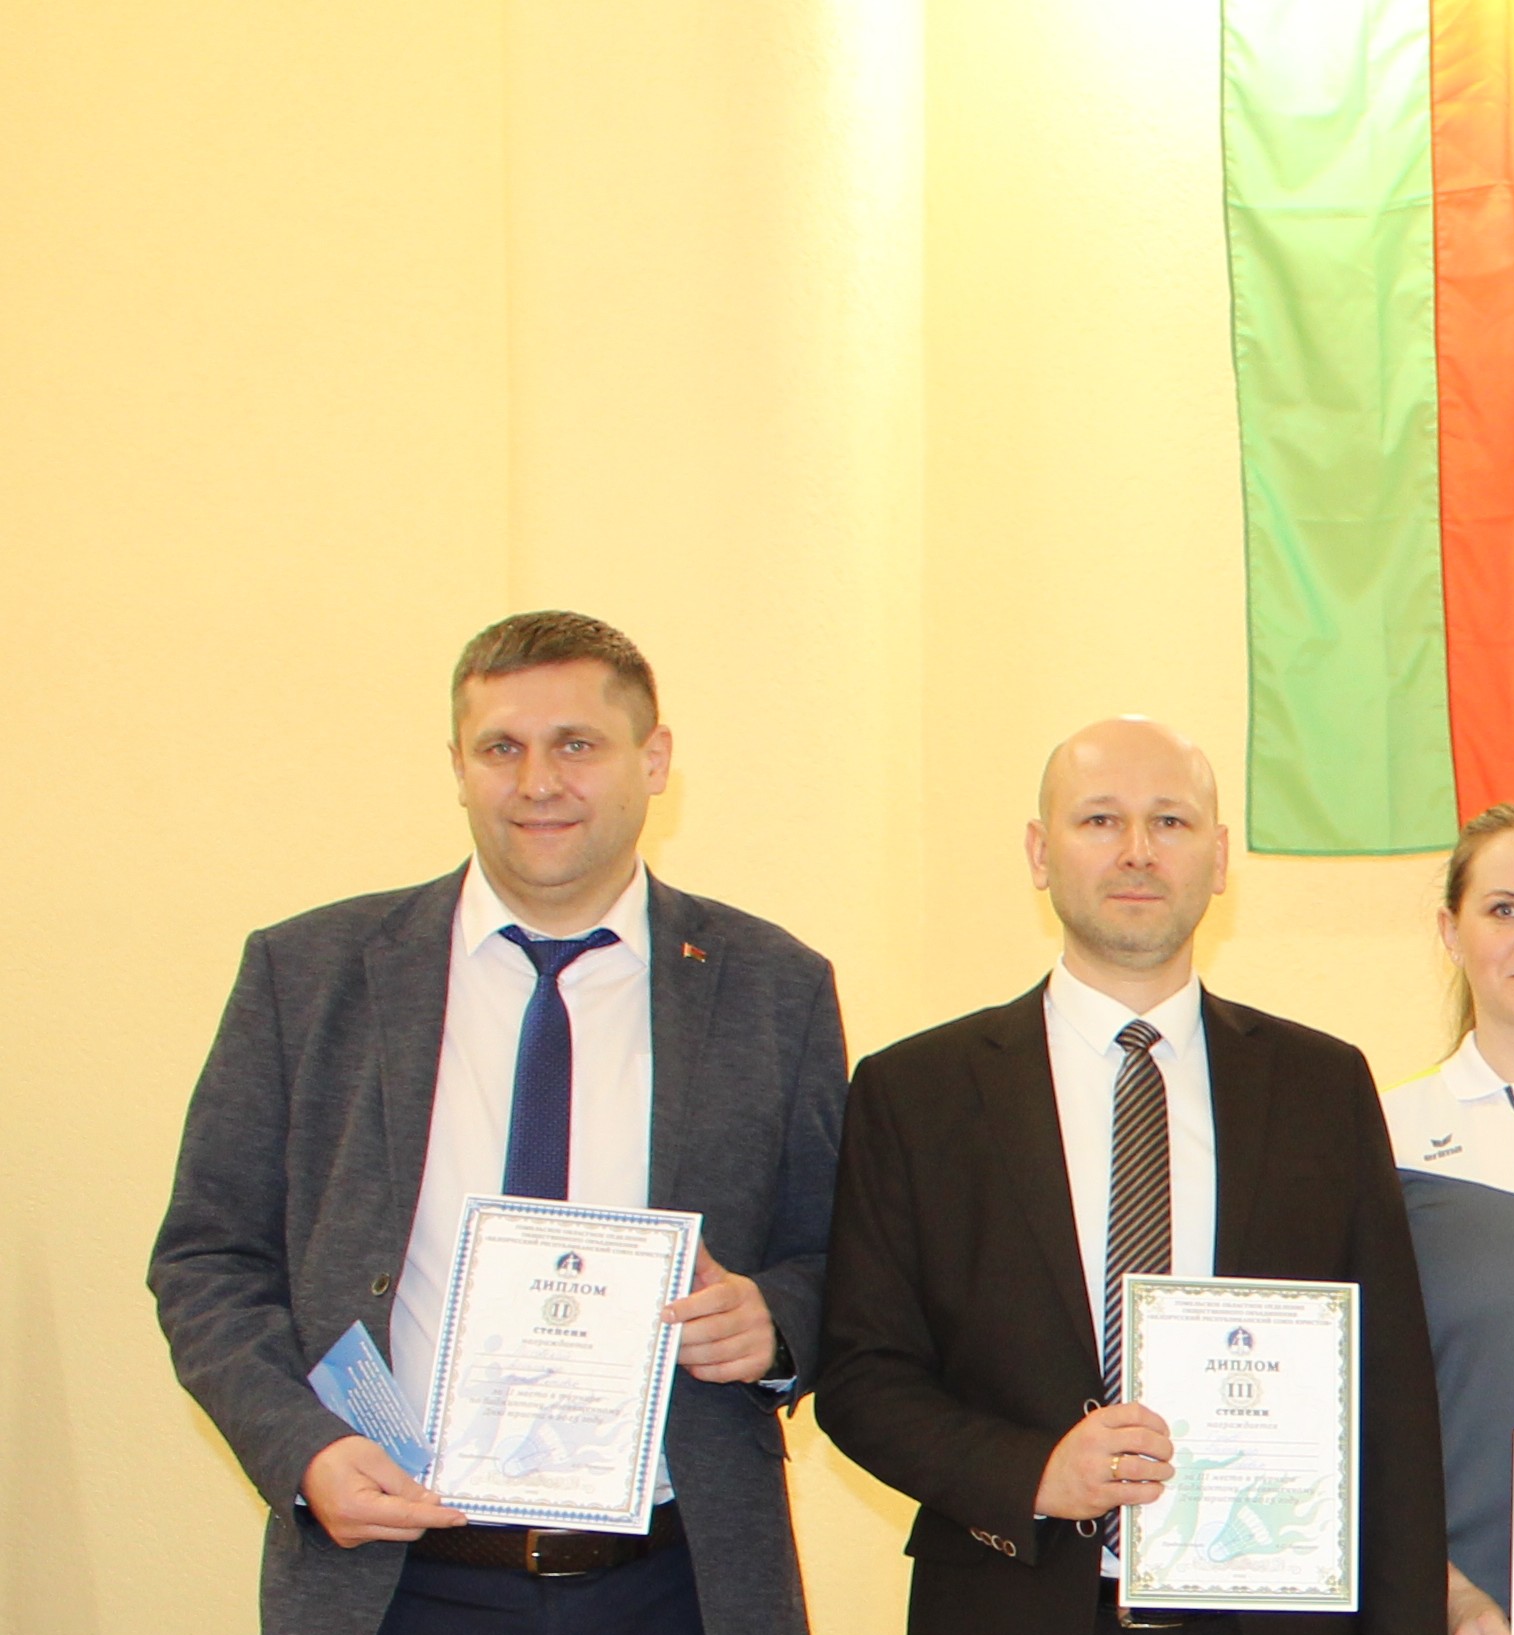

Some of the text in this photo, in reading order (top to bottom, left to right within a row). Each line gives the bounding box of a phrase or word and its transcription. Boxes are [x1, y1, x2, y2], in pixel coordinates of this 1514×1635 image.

[529, 1278, 608, 1297] ДИПЛОМ
[552, 1303, 571, 1319] II
[533, 1327, 588, 1338] степени
[1204, 1358, 1280, 1373] ДИПЛОМ
[1227, 1383, 1253, 1398] III
[1215, 1408, 1270, 1417] степени
